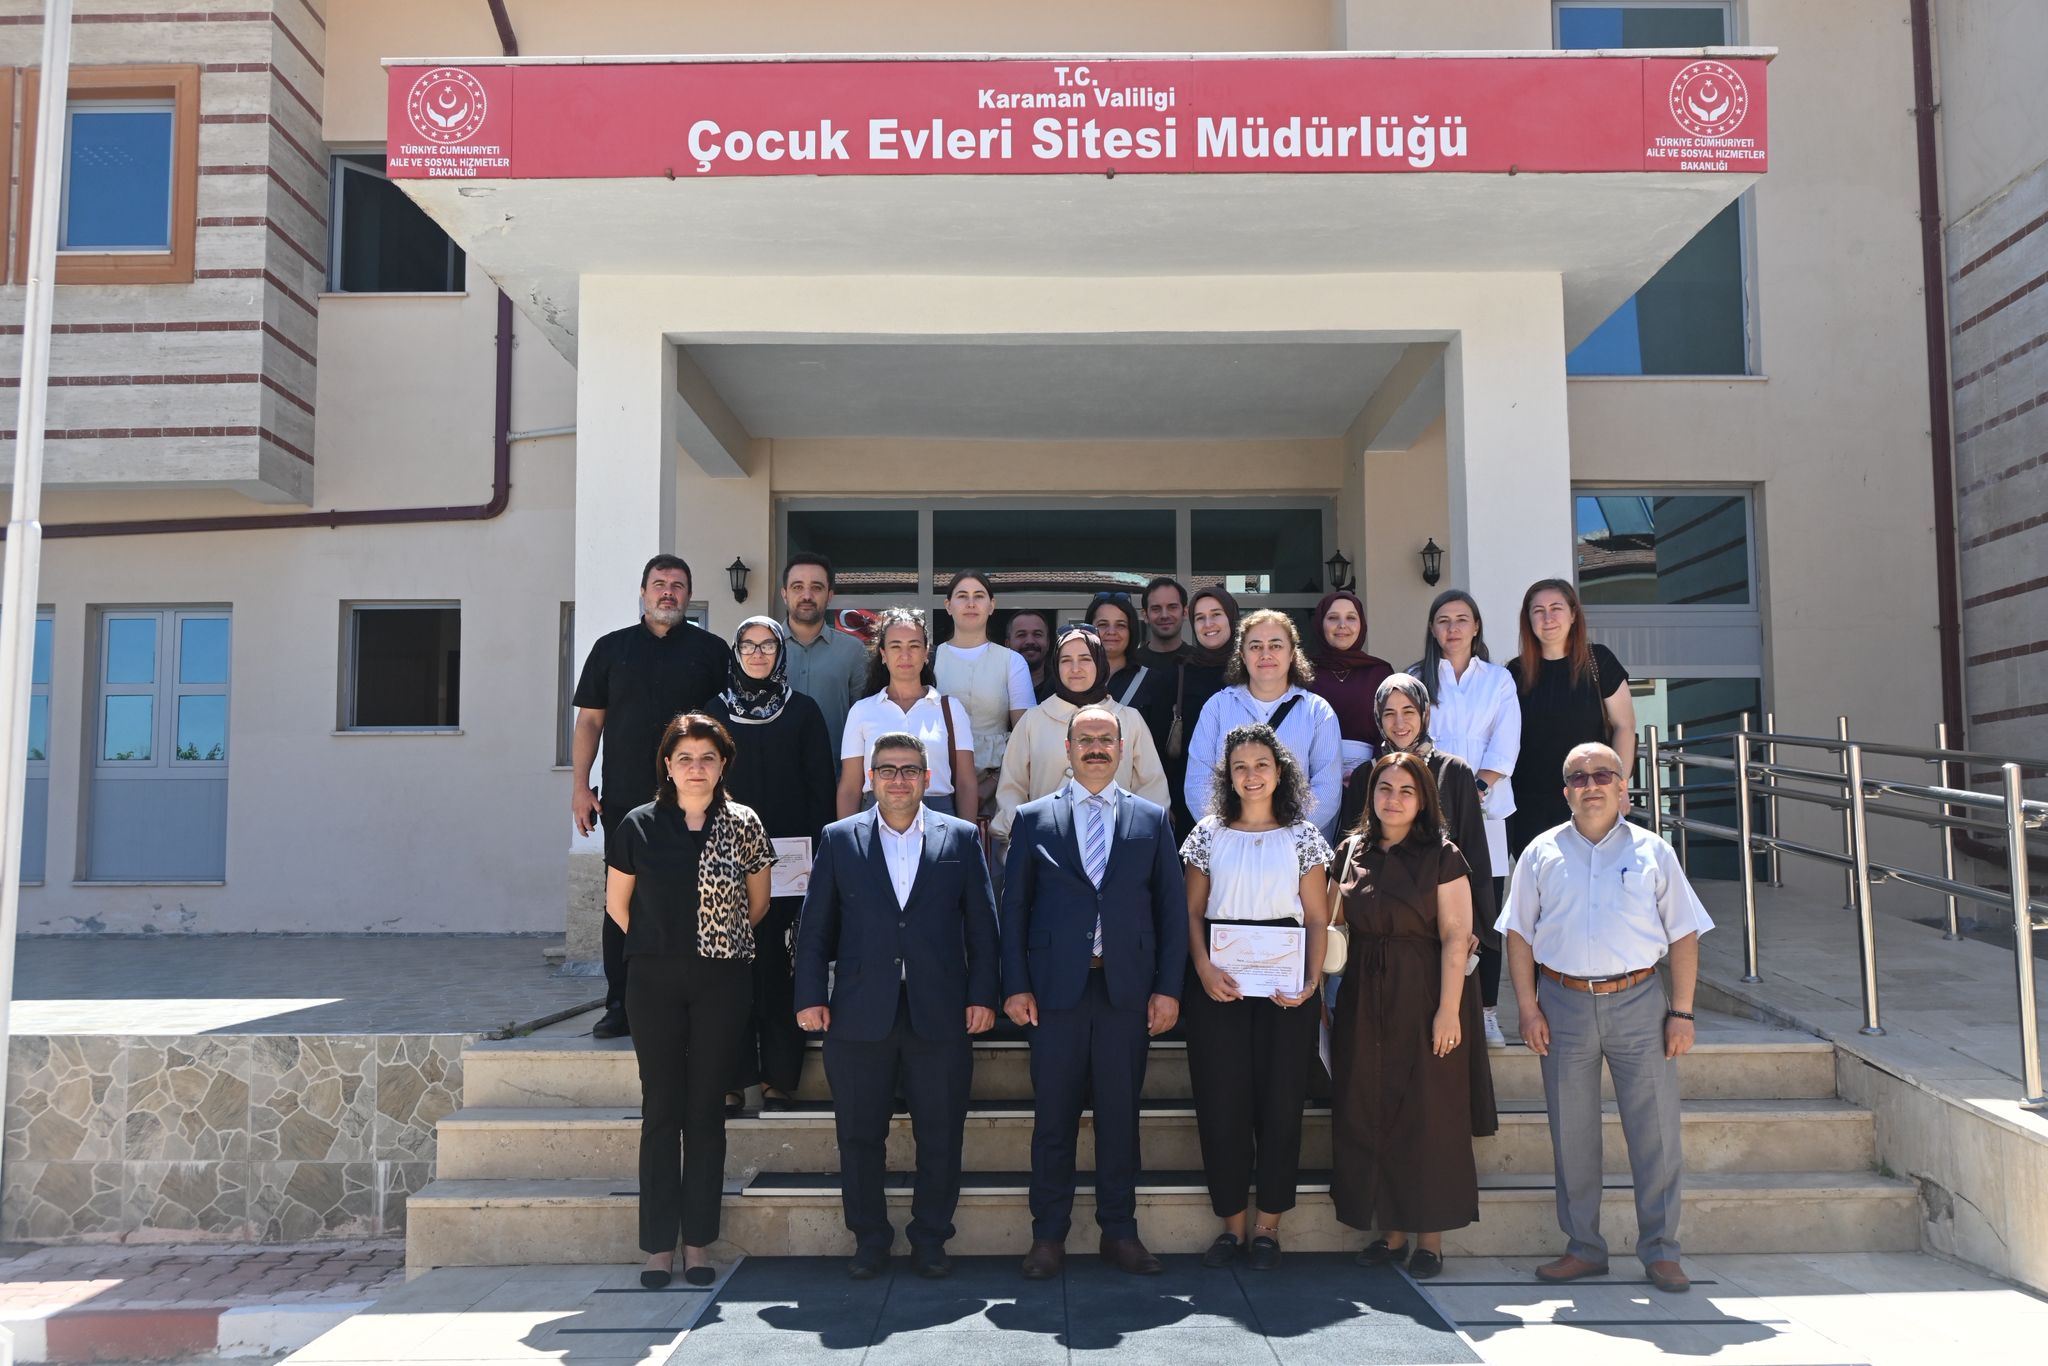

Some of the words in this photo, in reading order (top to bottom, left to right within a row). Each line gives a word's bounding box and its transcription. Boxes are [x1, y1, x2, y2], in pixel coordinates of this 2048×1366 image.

[1054, 67, 1097, 86] T.C.
[978, 89, 1086, 109] Karaman
[1094, 86, 1176, 112] Valiligi
[687, 119, 850, 174] Çocuk
[868, 118, 1012, 160] Evleri
[1031, 118, 1177, 160] Sitesi
[1197, 115, 1468, 169] Müdürlüğü
[1668, 148, 1679, 158] VE
[1681, 149, 1714, 158] SOSYAL
[411, 158, 423, 167] VE
[425, 158, 458, 167] SOSYAL
[1681, 160, 1728, 171] BAKANLIĞI
[429, 166, 477, 177] BAKANLIĞI
